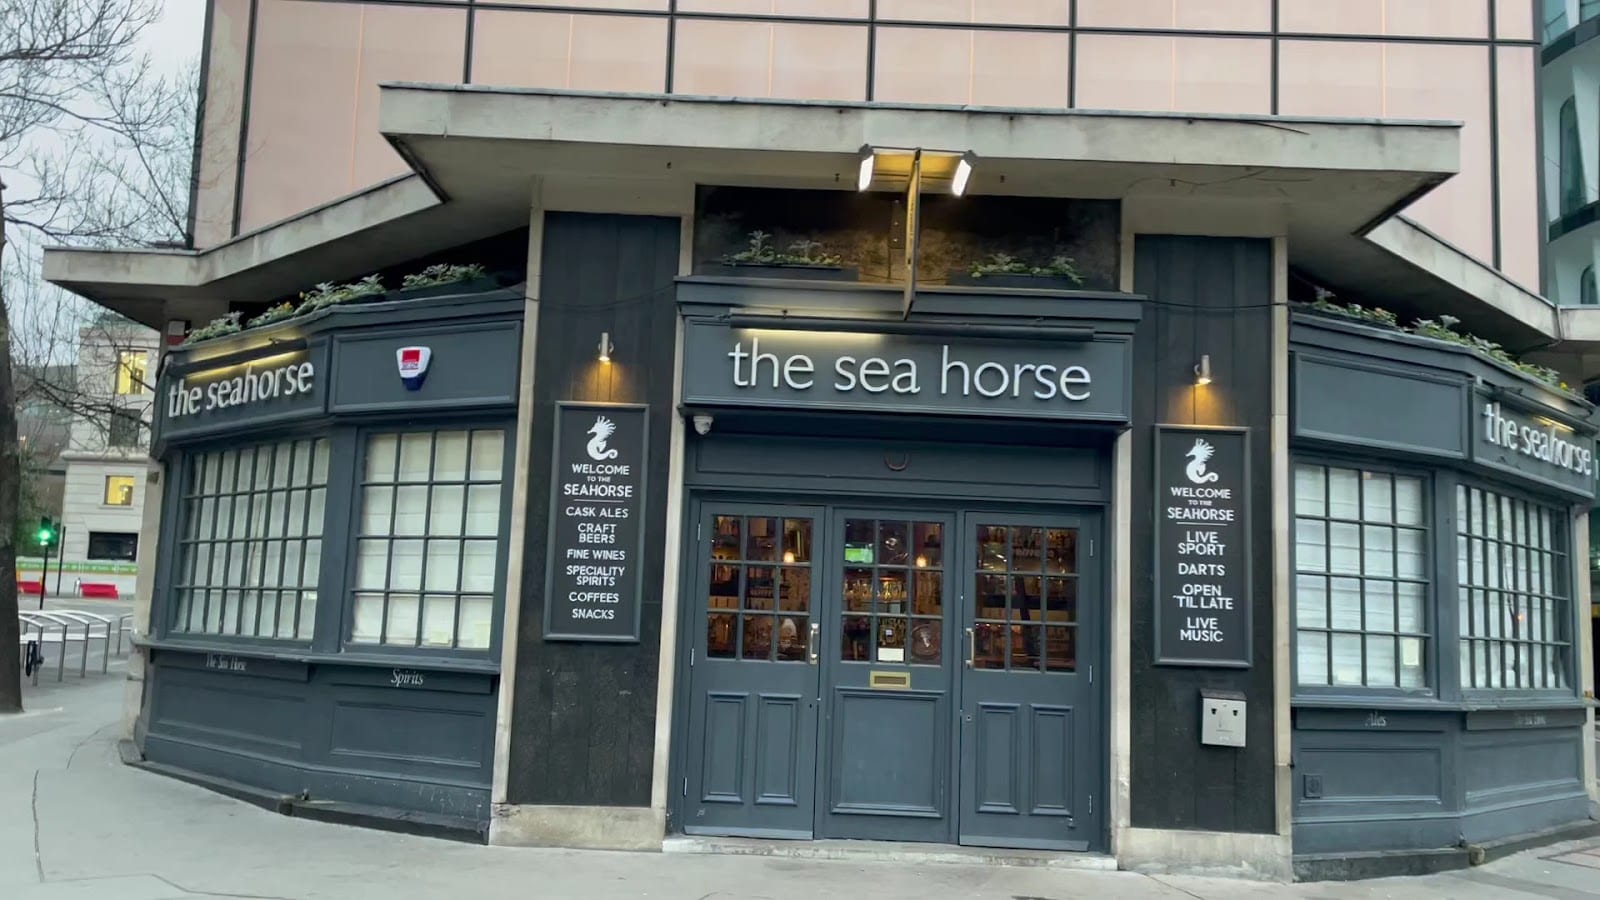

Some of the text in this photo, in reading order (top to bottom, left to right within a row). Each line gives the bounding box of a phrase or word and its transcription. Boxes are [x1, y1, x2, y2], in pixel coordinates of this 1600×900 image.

[728, 337, 1092, 401] the sea horse
[168, 361, 314, 418] the seahorse
[1484, 402, 1592, 475] the seahorse
[571, 463, 630, 476] WELCOME
[598, 475, 611, 483] THE
[563, 483, 633, 498] SEAHORSE
[1170, 486, 1231, 499] WELCOME
[1199, 499, 1212, 507] THE
[565, 506, 629, 518] CASK ALES
[1167, 506, 1234, 521] SEAHORSE
[577, 522, 617, 534] CRAFT
[578, 532, 616, 544] BEERS
[1186, 530, 1218, 544] LIVE
[566, 548, 626, 561] FINE WINES
[1177, 542, 1226, 556] SPORT
[566, 564, 626, 577] SPECIALITY
[1178, 562, 1226, 576] DARTS
[576, 575, 616, 586] SPIRITS
[1181, 583, 1222, 597] OPEN
[568, 591, 620, 604] COFFEES
[1200, 596, 1234, 610] LATE
[571, 608, 615, 620] SNACKS
[1186, 616, 1218, 630] LIVE
[1179, 628, 1224, 643] MUSIC
[390, 668, 425, 688] Spirits
